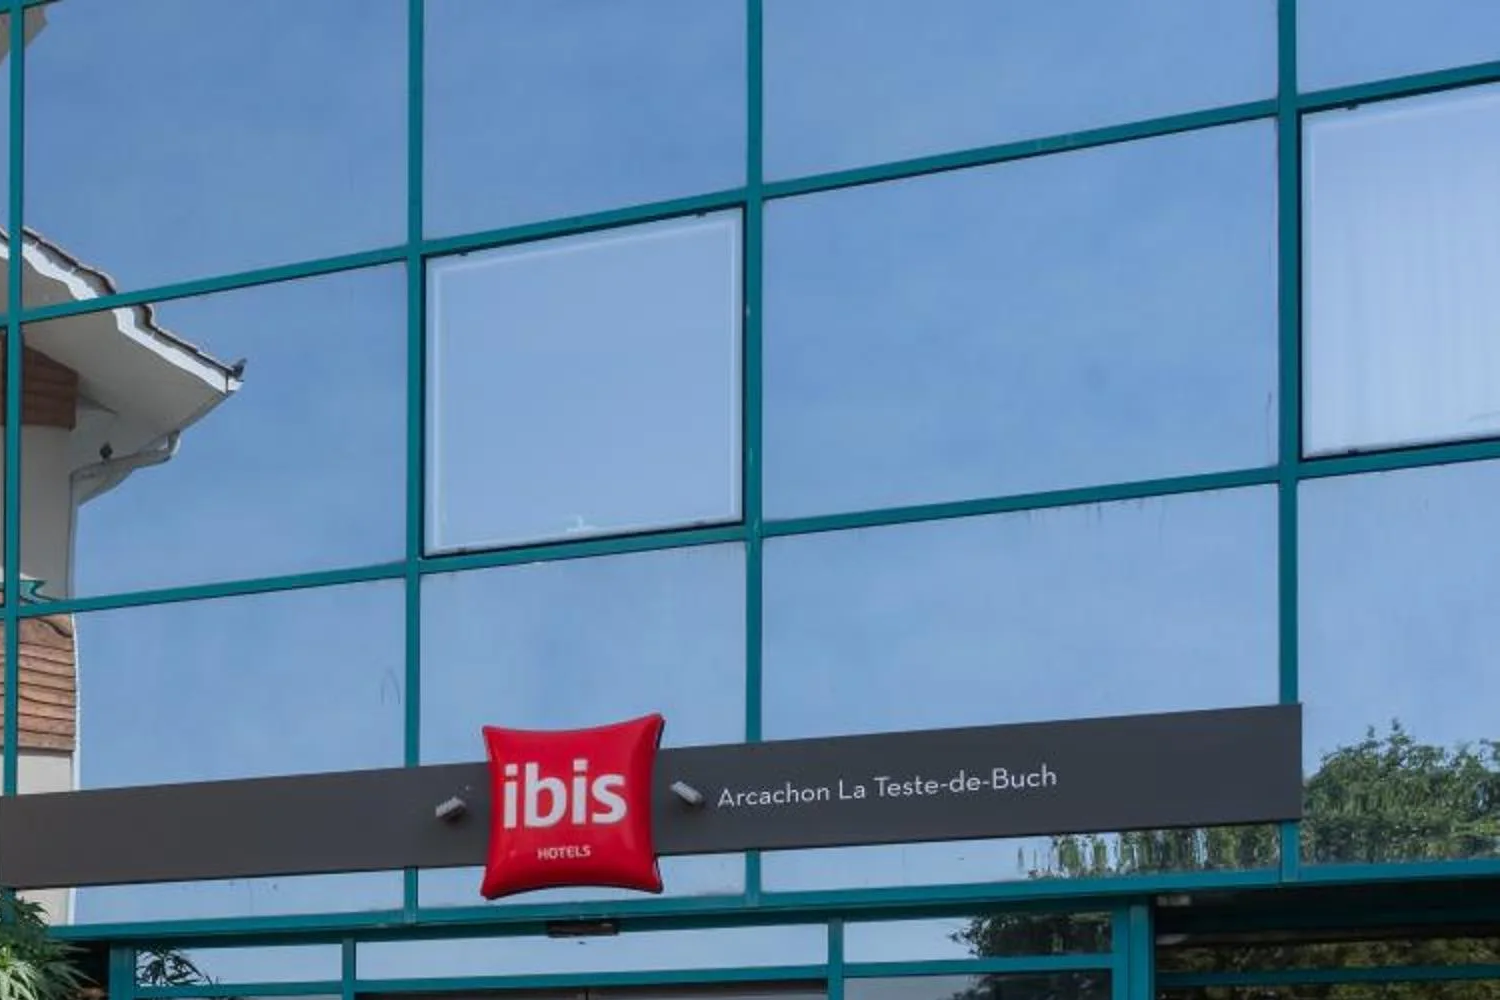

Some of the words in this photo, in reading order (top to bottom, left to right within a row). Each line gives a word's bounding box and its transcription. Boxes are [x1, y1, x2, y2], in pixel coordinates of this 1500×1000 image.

[503, 758, 627, 829] ibis
[717, 780, 830, 807] Arcachon
[838, 778, 866, 800] La
[873, 763, 1058, 797] Teste-de-Buch
[537, 845, 592, 861] HOTELS
